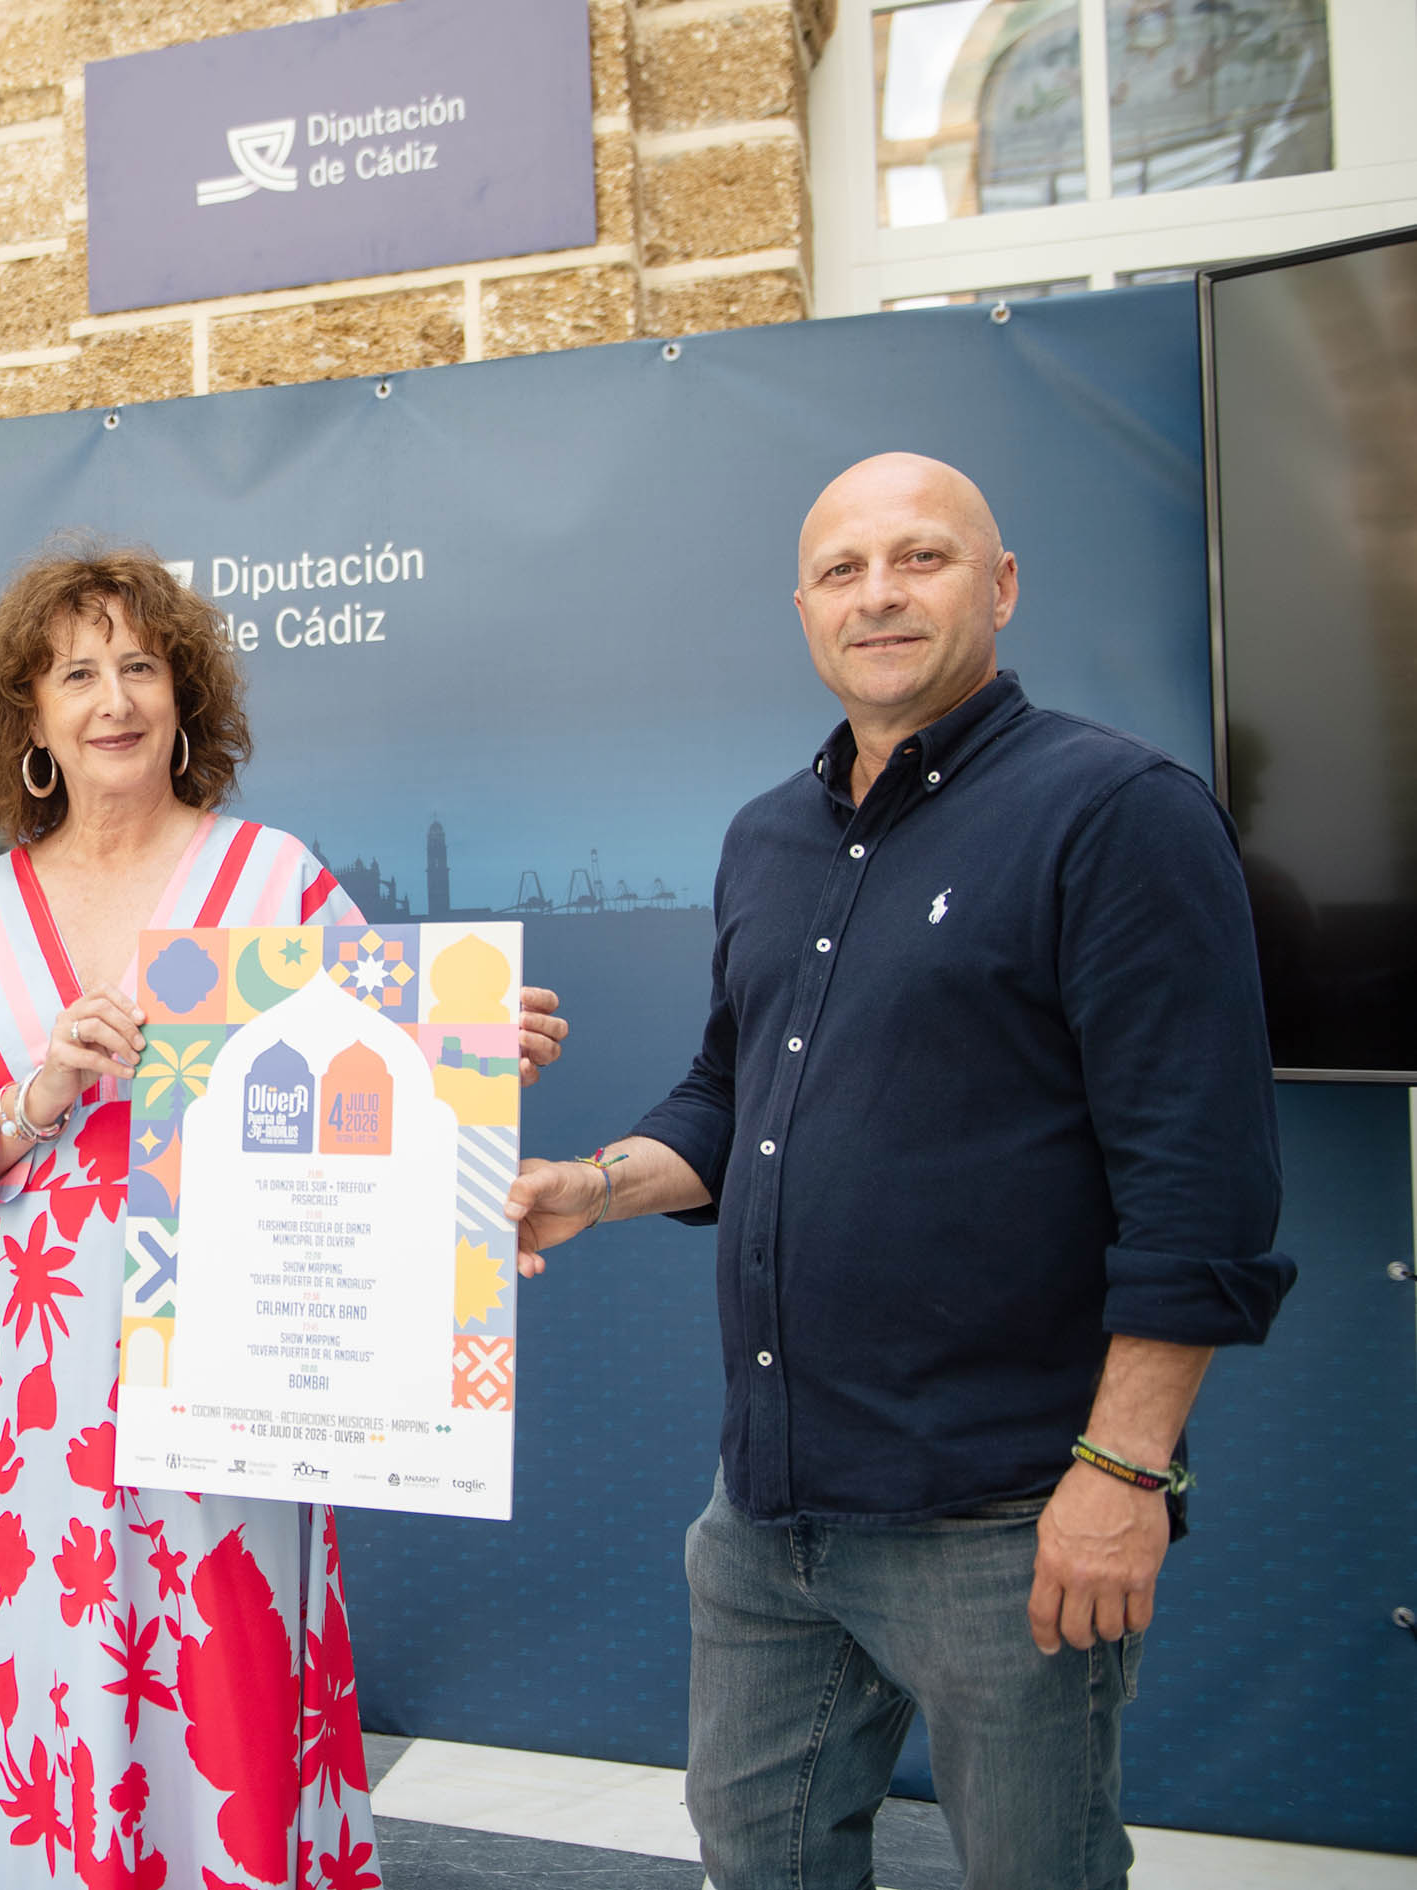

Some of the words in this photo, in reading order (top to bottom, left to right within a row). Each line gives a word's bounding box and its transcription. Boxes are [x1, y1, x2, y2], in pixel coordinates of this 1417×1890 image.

[308, 95, 466, 147] Diputación
[309, 156, 345, 188] de
[356, 141, 439, 180] Cádiz
[212, 541, 424, 601] Diputación
[275, 603, 386, 648] Cádiz
[328, 1093, 343, 1131] 4
[345, 1093, 379, 1112] JULIO
[345, 1113, 379, 1132] 2026
[270, 1180, 294, 1191] DANZA
[296, 1181, 309, 1192] DEL
[292, 1194, 338, 1206] PASACALLES
[258, 1220, 298, 1232] FLASHMOB
[300, 1221, 332, 1233] ESCUELA
[334, 1222, 344, 1234] DE
[346, 1222, 371, 1235] DANZA
[272, 1234, 313, 1247] MUNICIPAL
[315, 1235, 325, 1247] DE
[327, 1236, 355, 1248] OLVERA
[282, 1262, 306, 1273] SHOW
[308, 1263, 342, 1275] MAPPING
[283, 1275, 312, 1287] PUERTA
[314, 1276, 323, 1288] DE
[325, 1277, 334, 1288] AL
[257, 1300, 305, 1317] CALAMITY
[308, 1303, 336, 1318] ROCK
[339, 1304, 367, 1320] BAND
[280, 1332, 303, 1344] SHOW
[306, 1334, 340, 1347] MAPPING
[281, 1346, 309, 1359] PUERTA
[311, 1348, 321, 1360] DE
[323, 1349, 332, 1360] AL
[289, 1374, 329, 1391] BOMBAI
[192, 1405, 221, 1417] COCINA
[223, 1407, 273, 1422] TRADICIONAL
[281, 1411, 335, 1427] ACTUACIONES
[338, 1415, 383, 1430] MUSICALES
[391, 1419, 430, 1434] MAPPING
[250, 1424, 255, 1435] 4
[257, 1424, 266, 1437] DE
[270, 1425, 291, 1438] JULIO
[293, 1426, 303, 1440] DE
[305, 1427, 327, 1441] 2026
[334, 1430, 365, 1444] OLVERA
